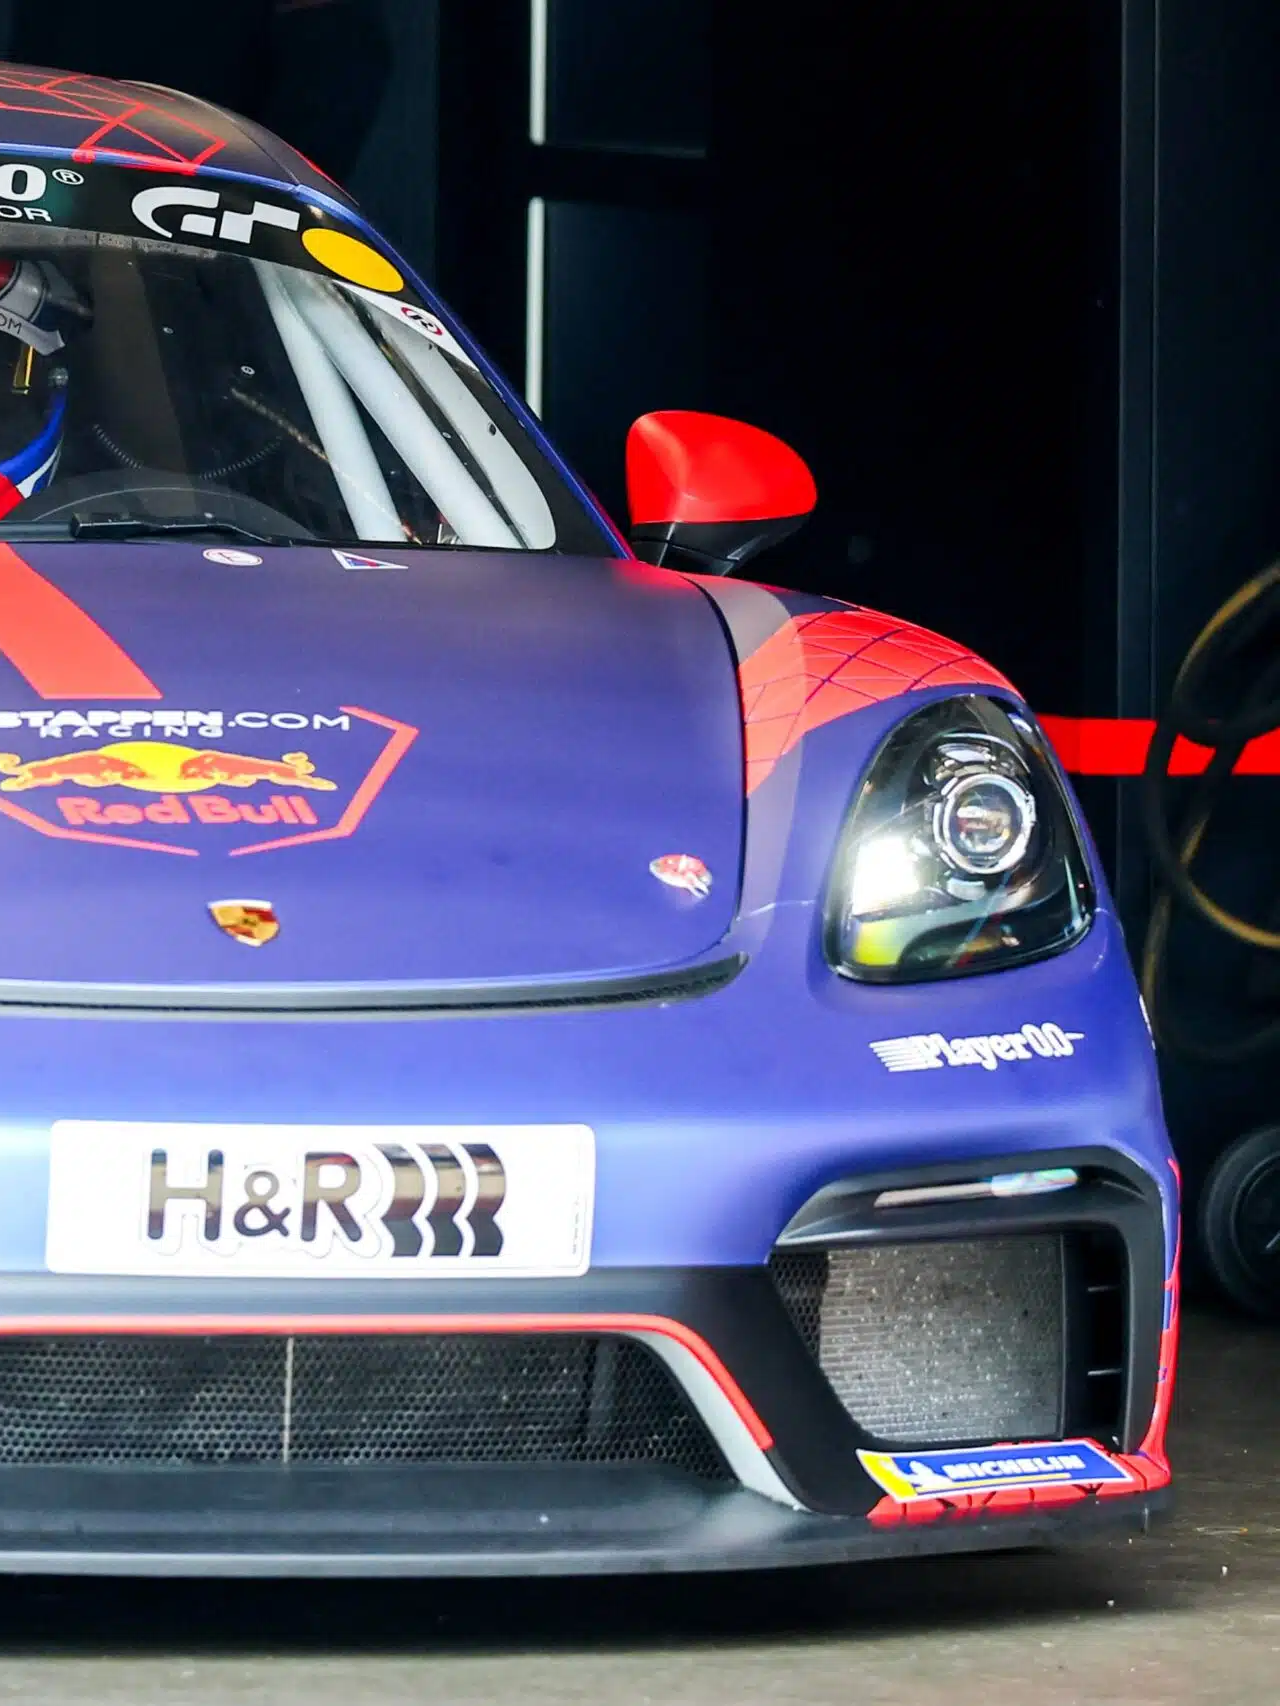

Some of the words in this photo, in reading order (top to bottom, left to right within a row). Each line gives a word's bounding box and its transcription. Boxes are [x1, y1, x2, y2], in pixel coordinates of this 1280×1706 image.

[38, 723, 224, 739] RACING
[56, 794, 191, 825] Red
[188, 794, 318, 825] Bull
[147, 1147, 363, 1242] H&R
[942, 1454, 1086, 1481] MICHELIN
